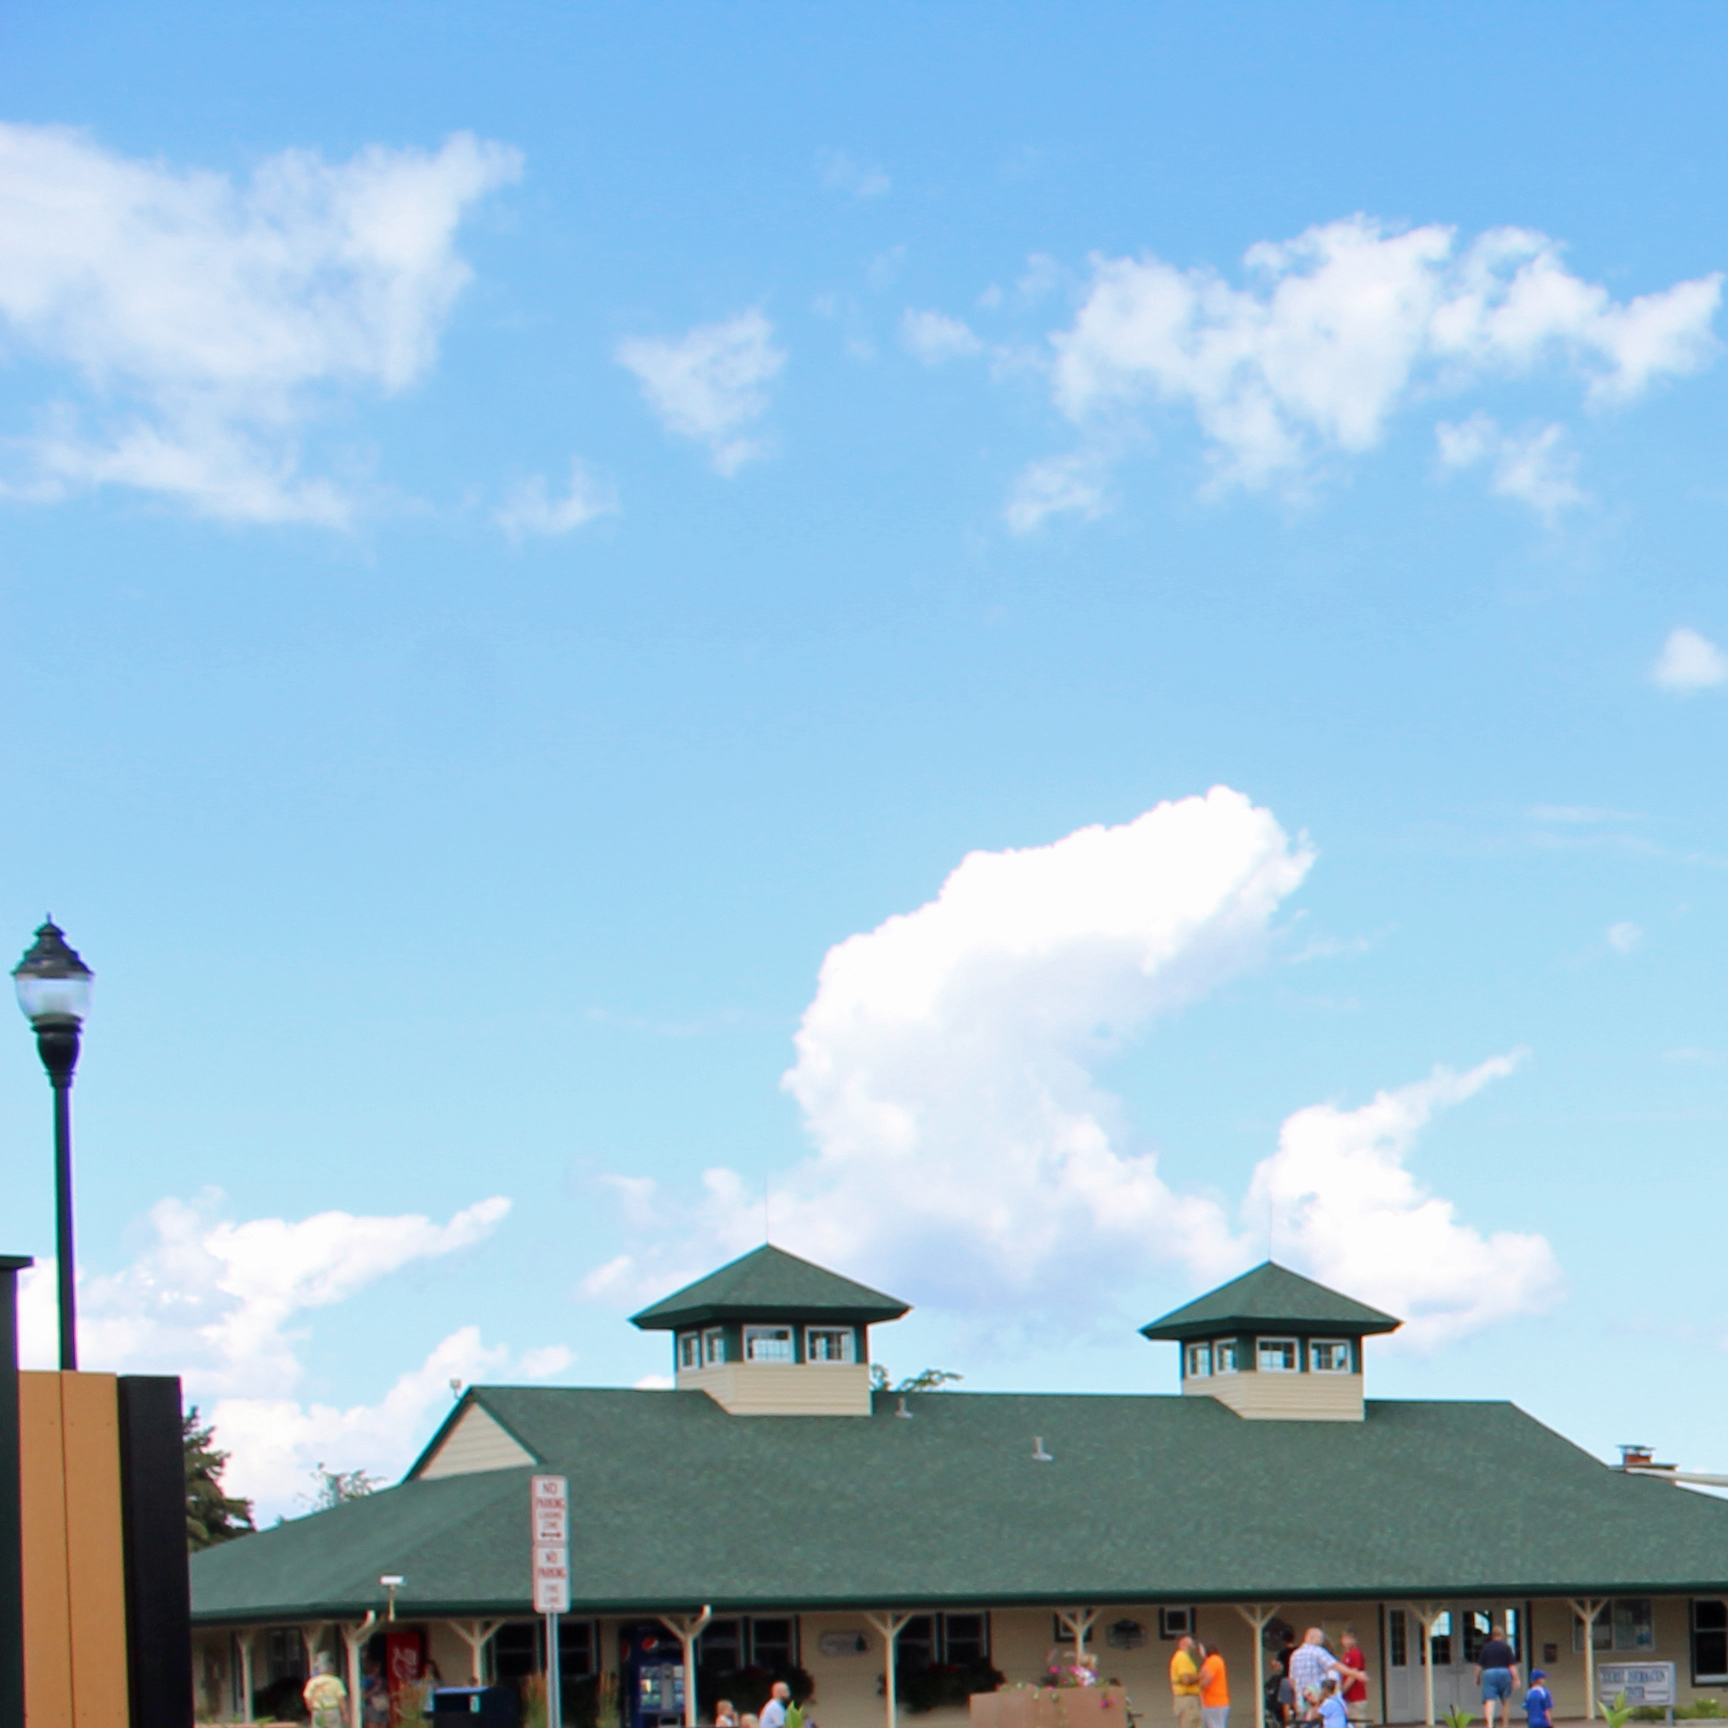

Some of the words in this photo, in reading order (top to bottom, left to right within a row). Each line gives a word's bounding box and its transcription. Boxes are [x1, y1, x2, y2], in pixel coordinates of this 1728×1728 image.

[542, 1482, 558, 1495] NO
[537, 1498, 566, 1508] PARKING
[545, 1552, 558, 1563] NO
[538, 1567, 567, 1578] PARKING
